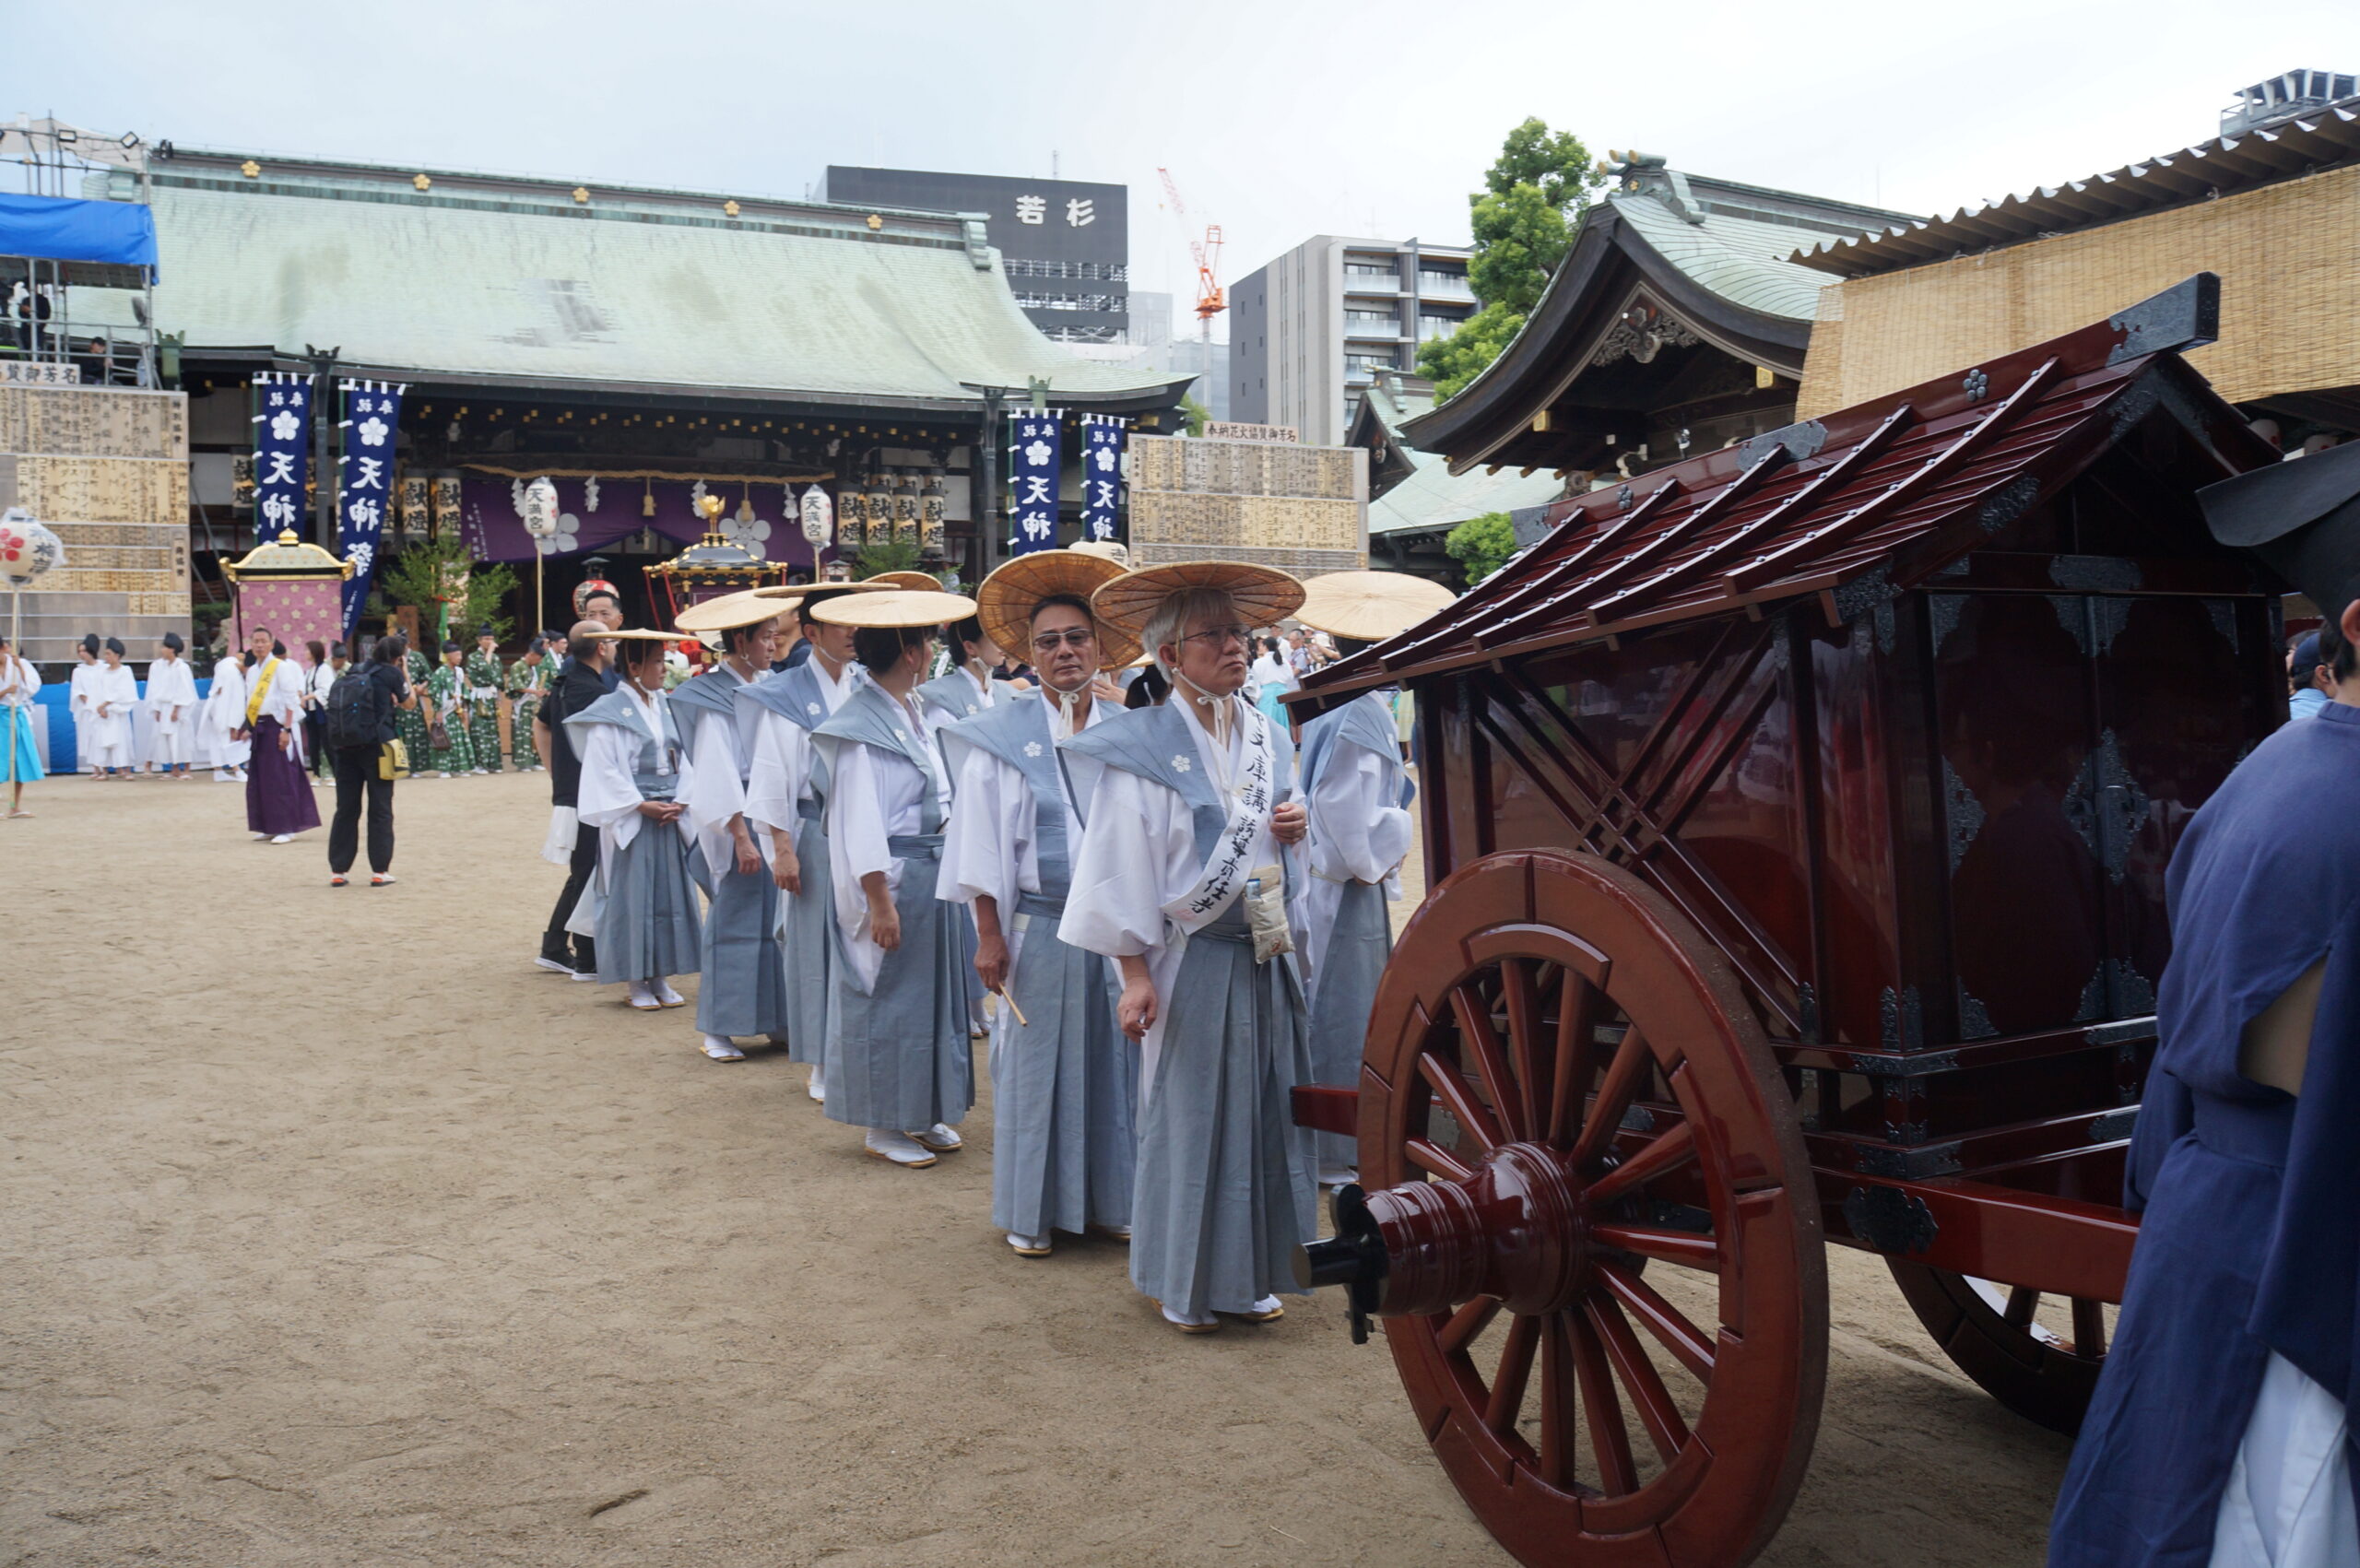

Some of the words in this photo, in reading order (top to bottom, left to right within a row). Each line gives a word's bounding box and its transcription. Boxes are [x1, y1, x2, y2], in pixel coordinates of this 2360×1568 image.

[1015, 195, 1096, 228] 若杉
[0, 362, 77, 384] 賛御芳名
[526, 487, 545, 531] 天満宮
[805, 495, 822, 537] 天満宮
